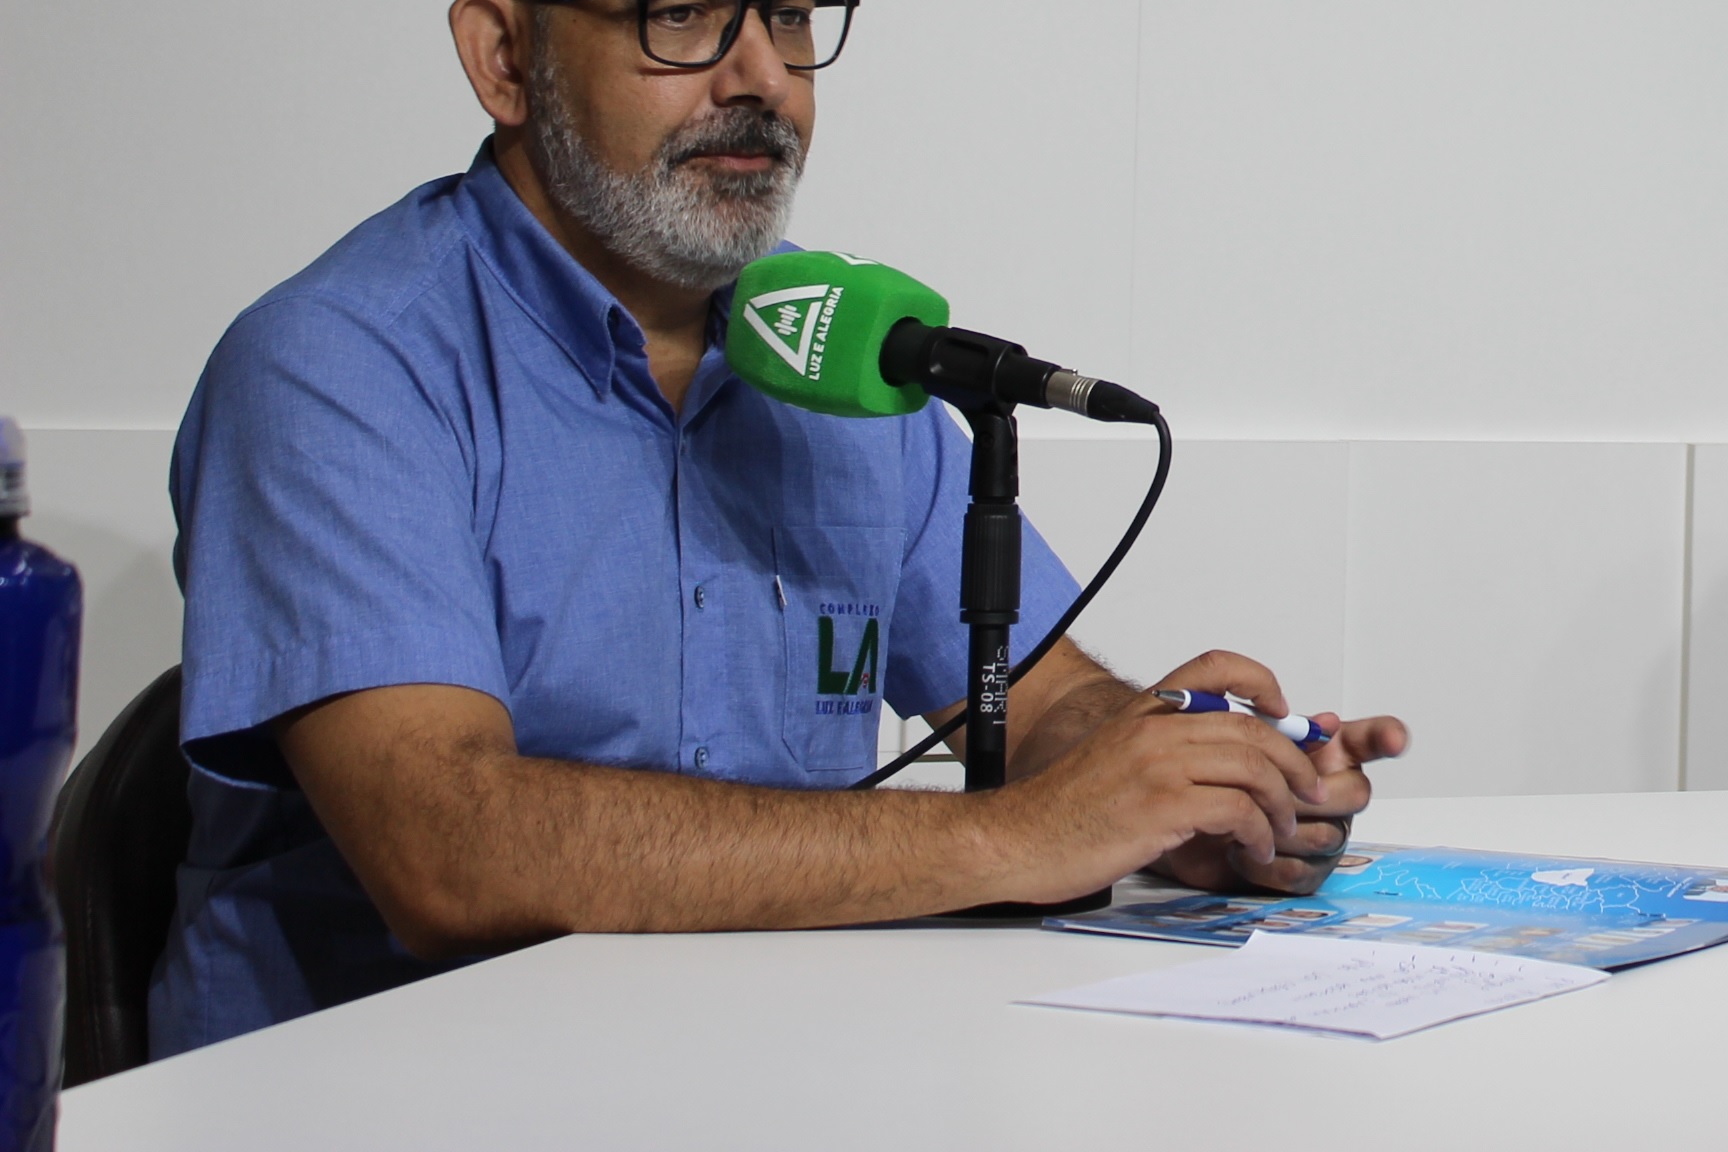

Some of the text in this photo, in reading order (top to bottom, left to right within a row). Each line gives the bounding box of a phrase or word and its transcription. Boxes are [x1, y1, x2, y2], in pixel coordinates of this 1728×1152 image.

[808, 287, 845, 381] LUZ E ALEGRIA
[817, 616, 879, 696] LA
[979, 662, 996, 713] TS-08
